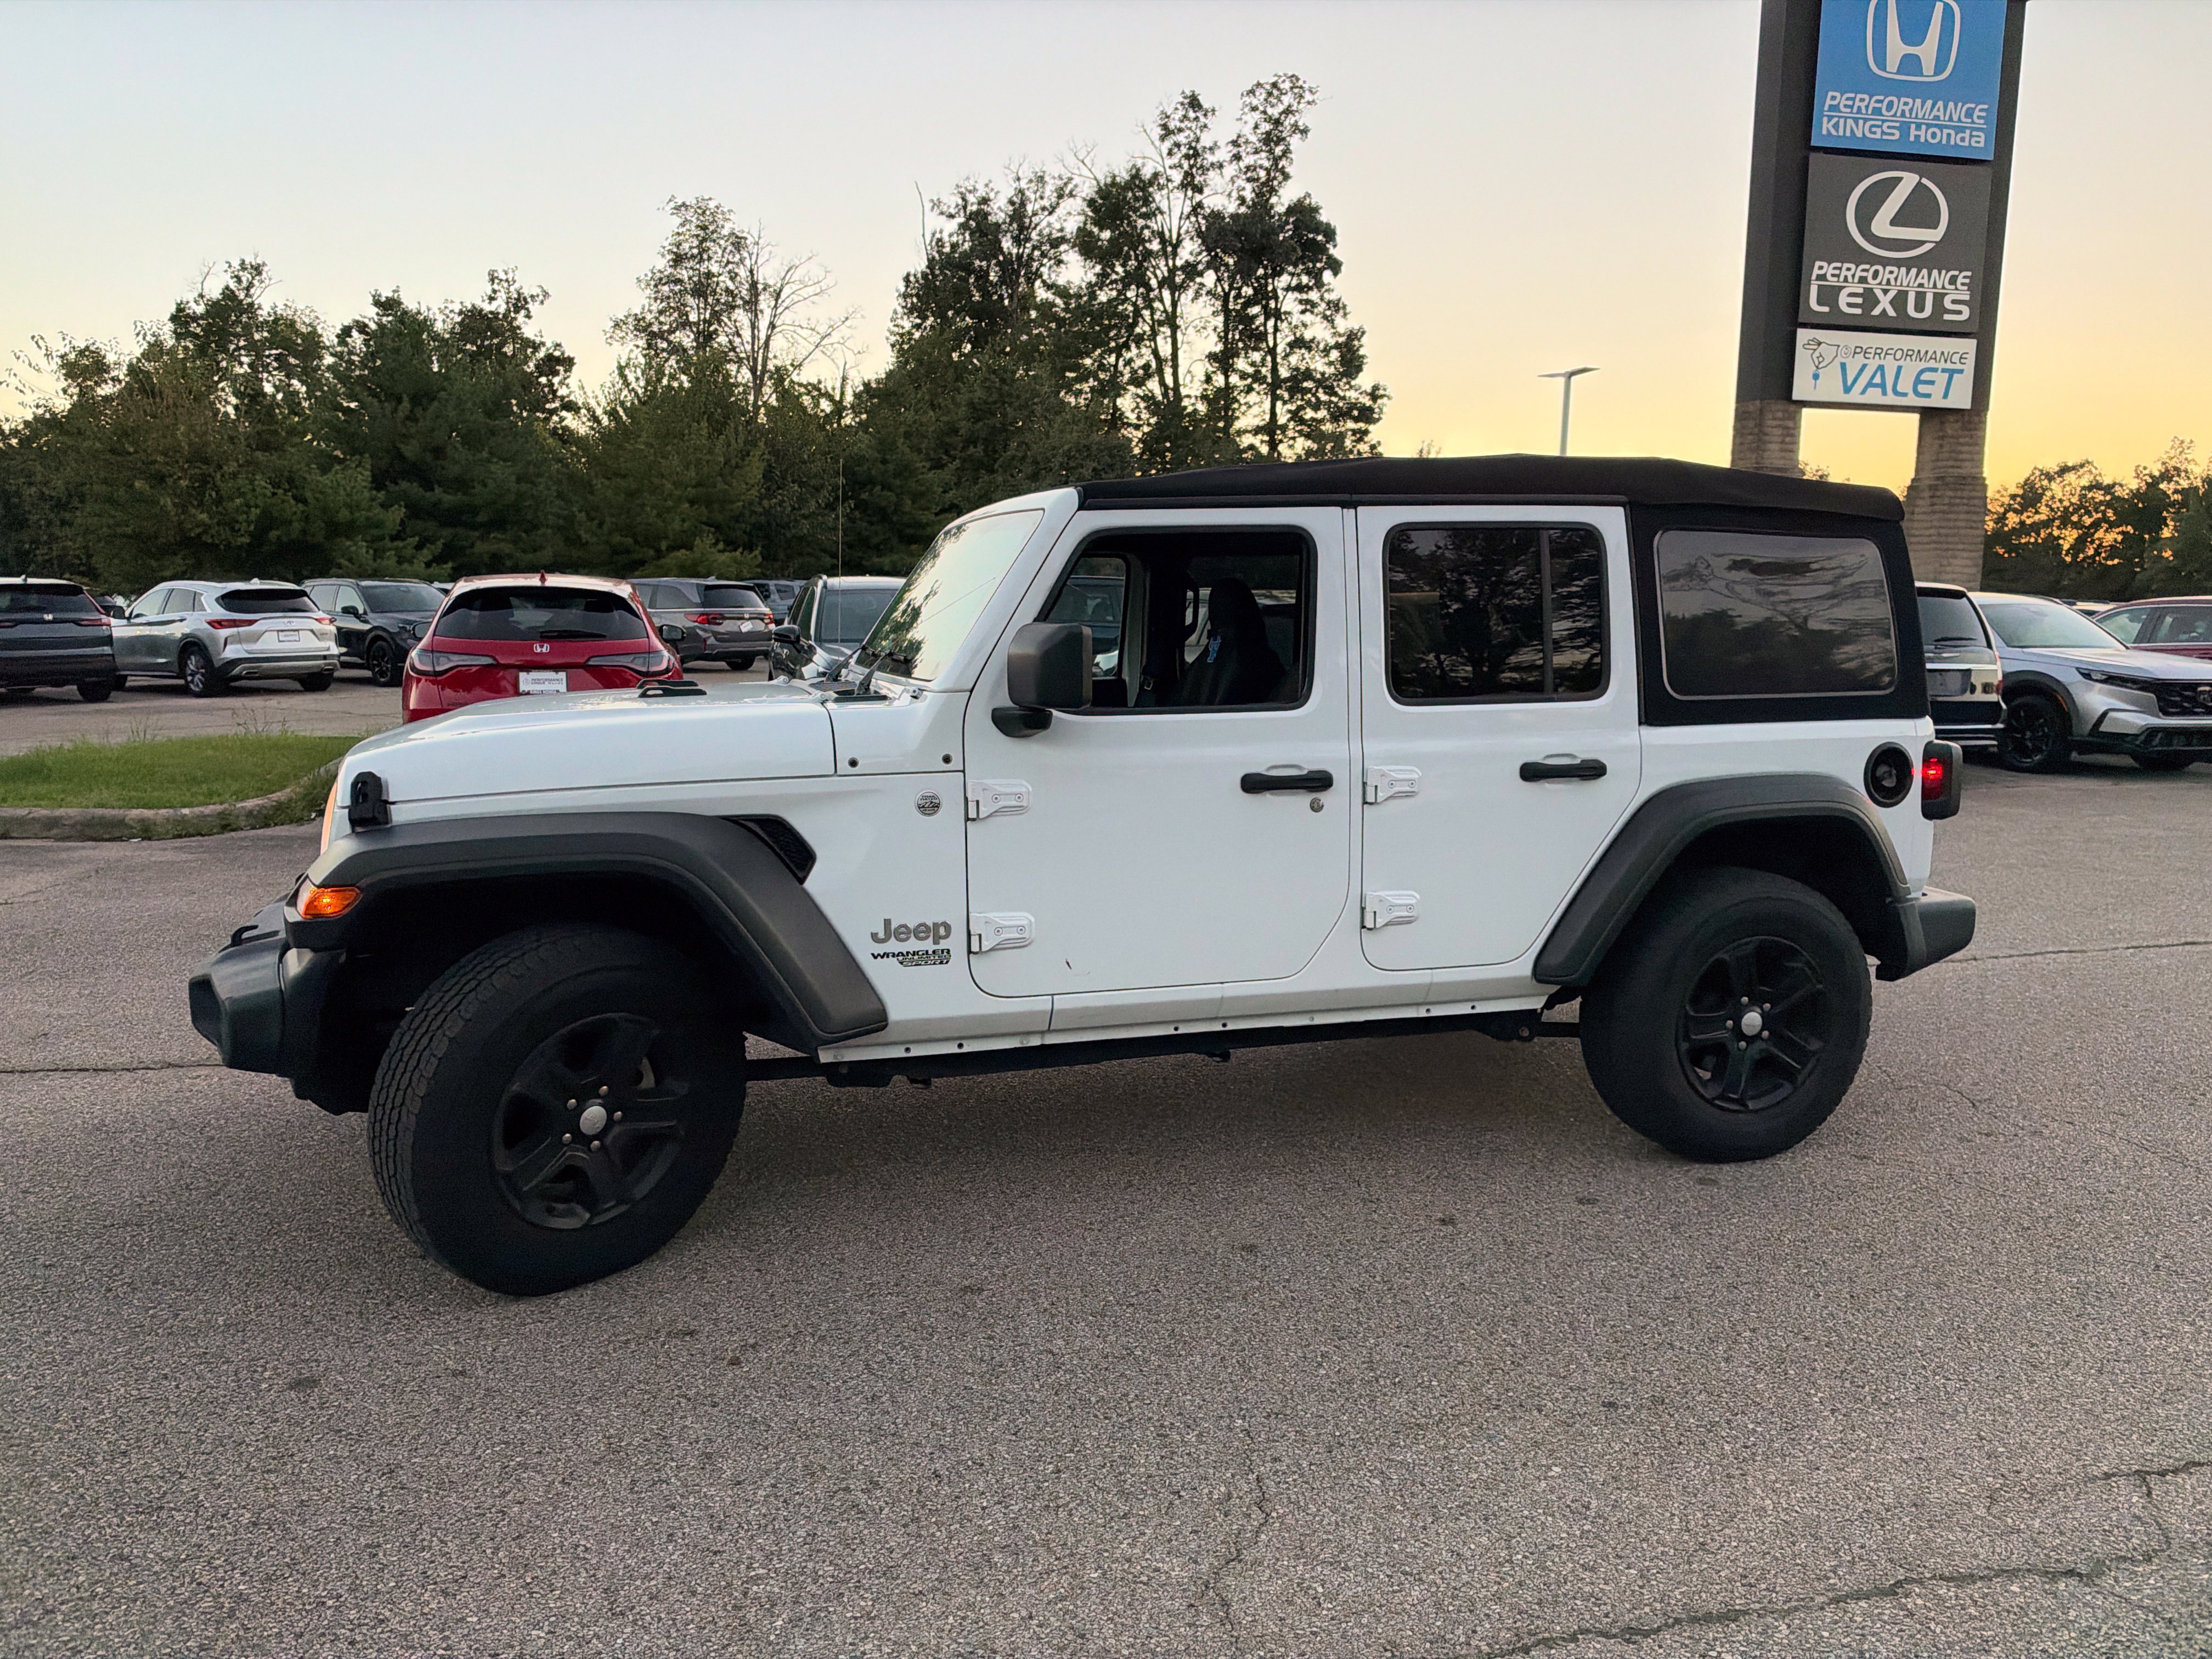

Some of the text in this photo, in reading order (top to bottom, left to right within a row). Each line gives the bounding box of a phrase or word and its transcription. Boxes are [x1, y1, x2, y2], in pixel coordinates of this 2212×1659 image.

[1824, 91, 1989, 124] PERFORMANCE
[1821, 116, 1985, 148] KINGS Honda
[1811, 261, 1972, 290] PERFORMANCE
[1809, 284, 1970, 321] LEXUS
[1852, 346, 1969, 365] PERFORMANCE
[1839, 362, 1965, 400] VALET
[871, 918, 952, 945] Jeep
[870, 948, 951, 960] WRANGLER
